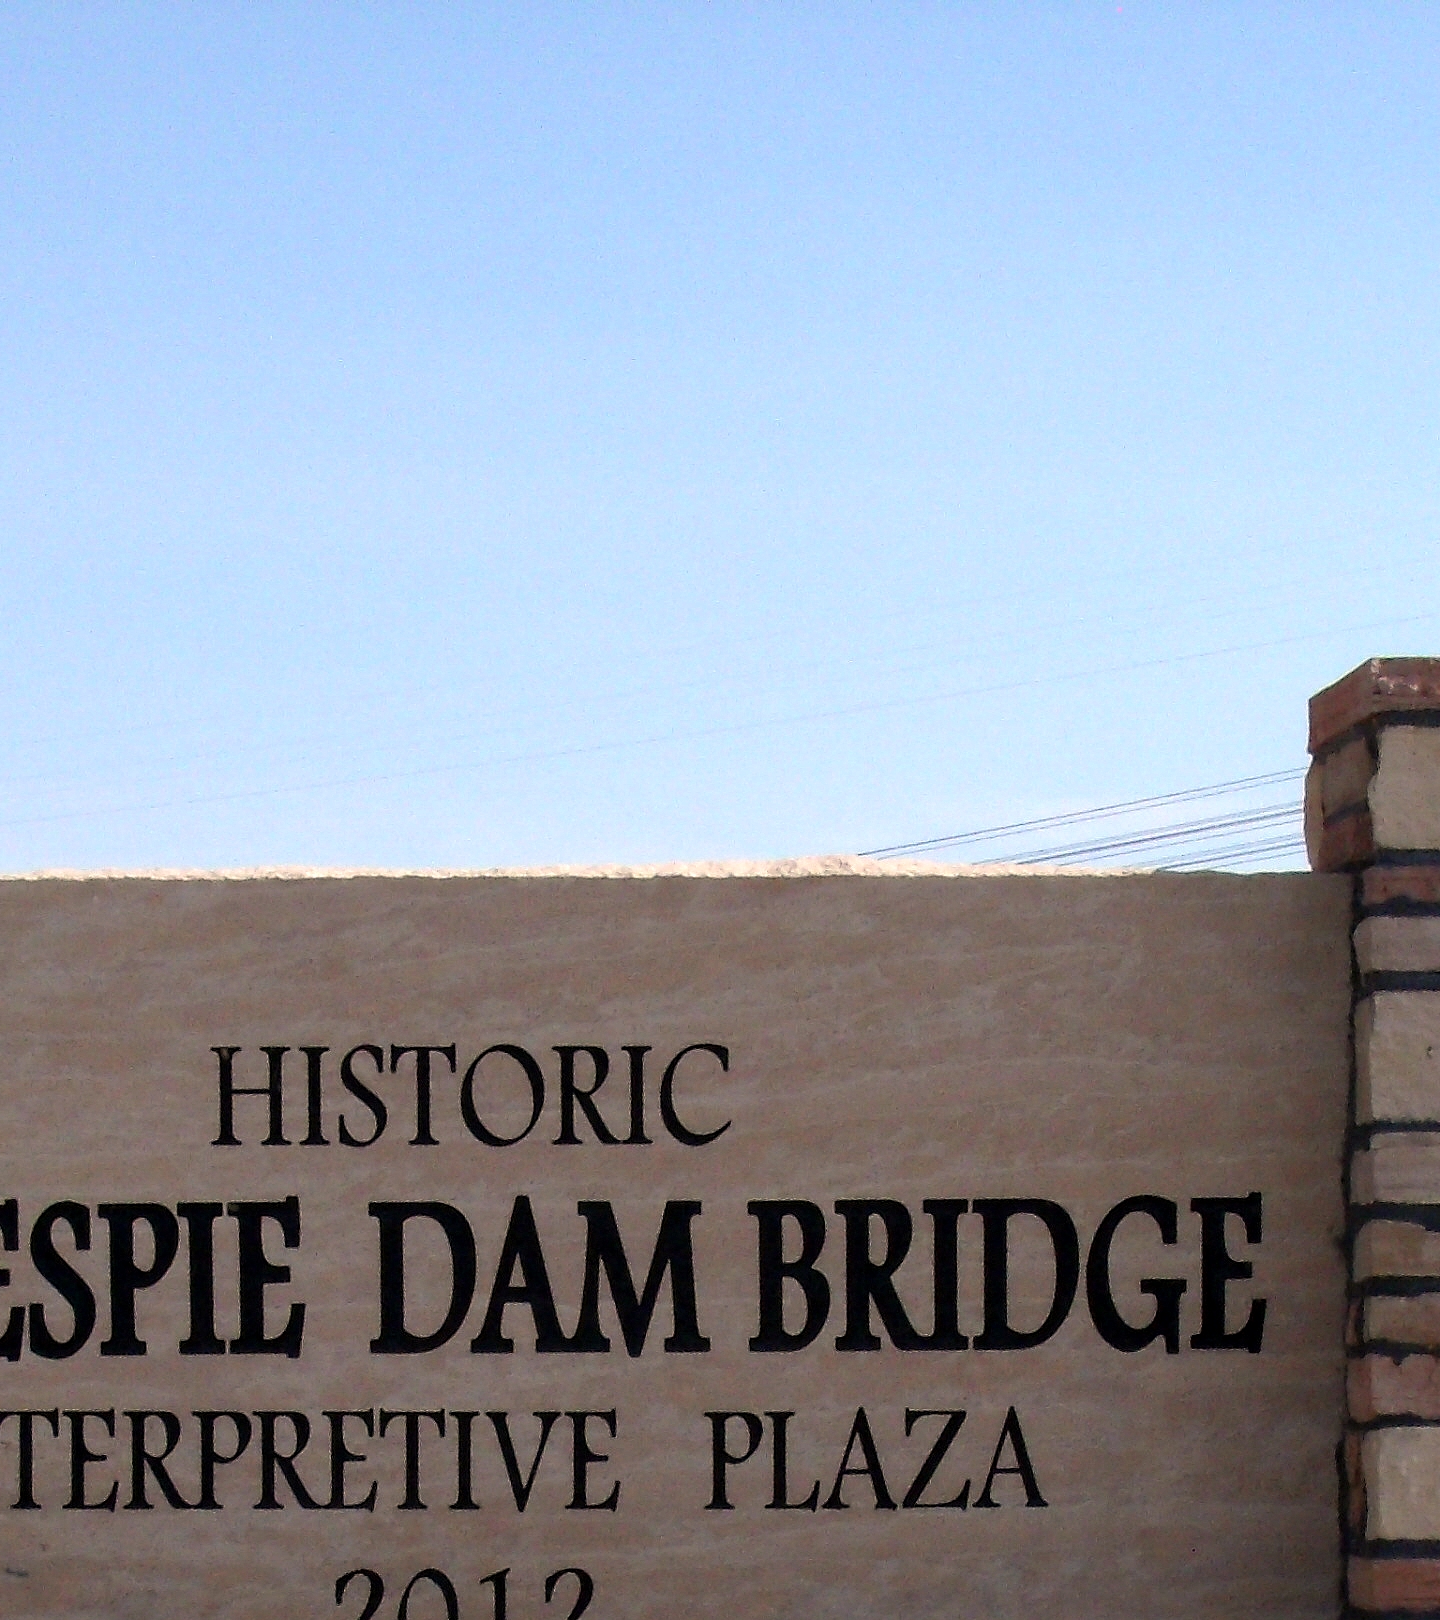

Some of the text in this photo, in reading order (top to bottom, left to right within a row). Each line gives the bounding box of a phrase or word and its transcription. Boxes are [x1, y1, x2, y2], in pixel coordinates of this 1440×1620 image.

[209, 1043, 733, 1148] HISTORIC
[367, 1195, 712, 1358] DAM
[746, 1190, 1268, 1357] BRIDGE
[702, 1405, 1050, 1514] PLAZA
